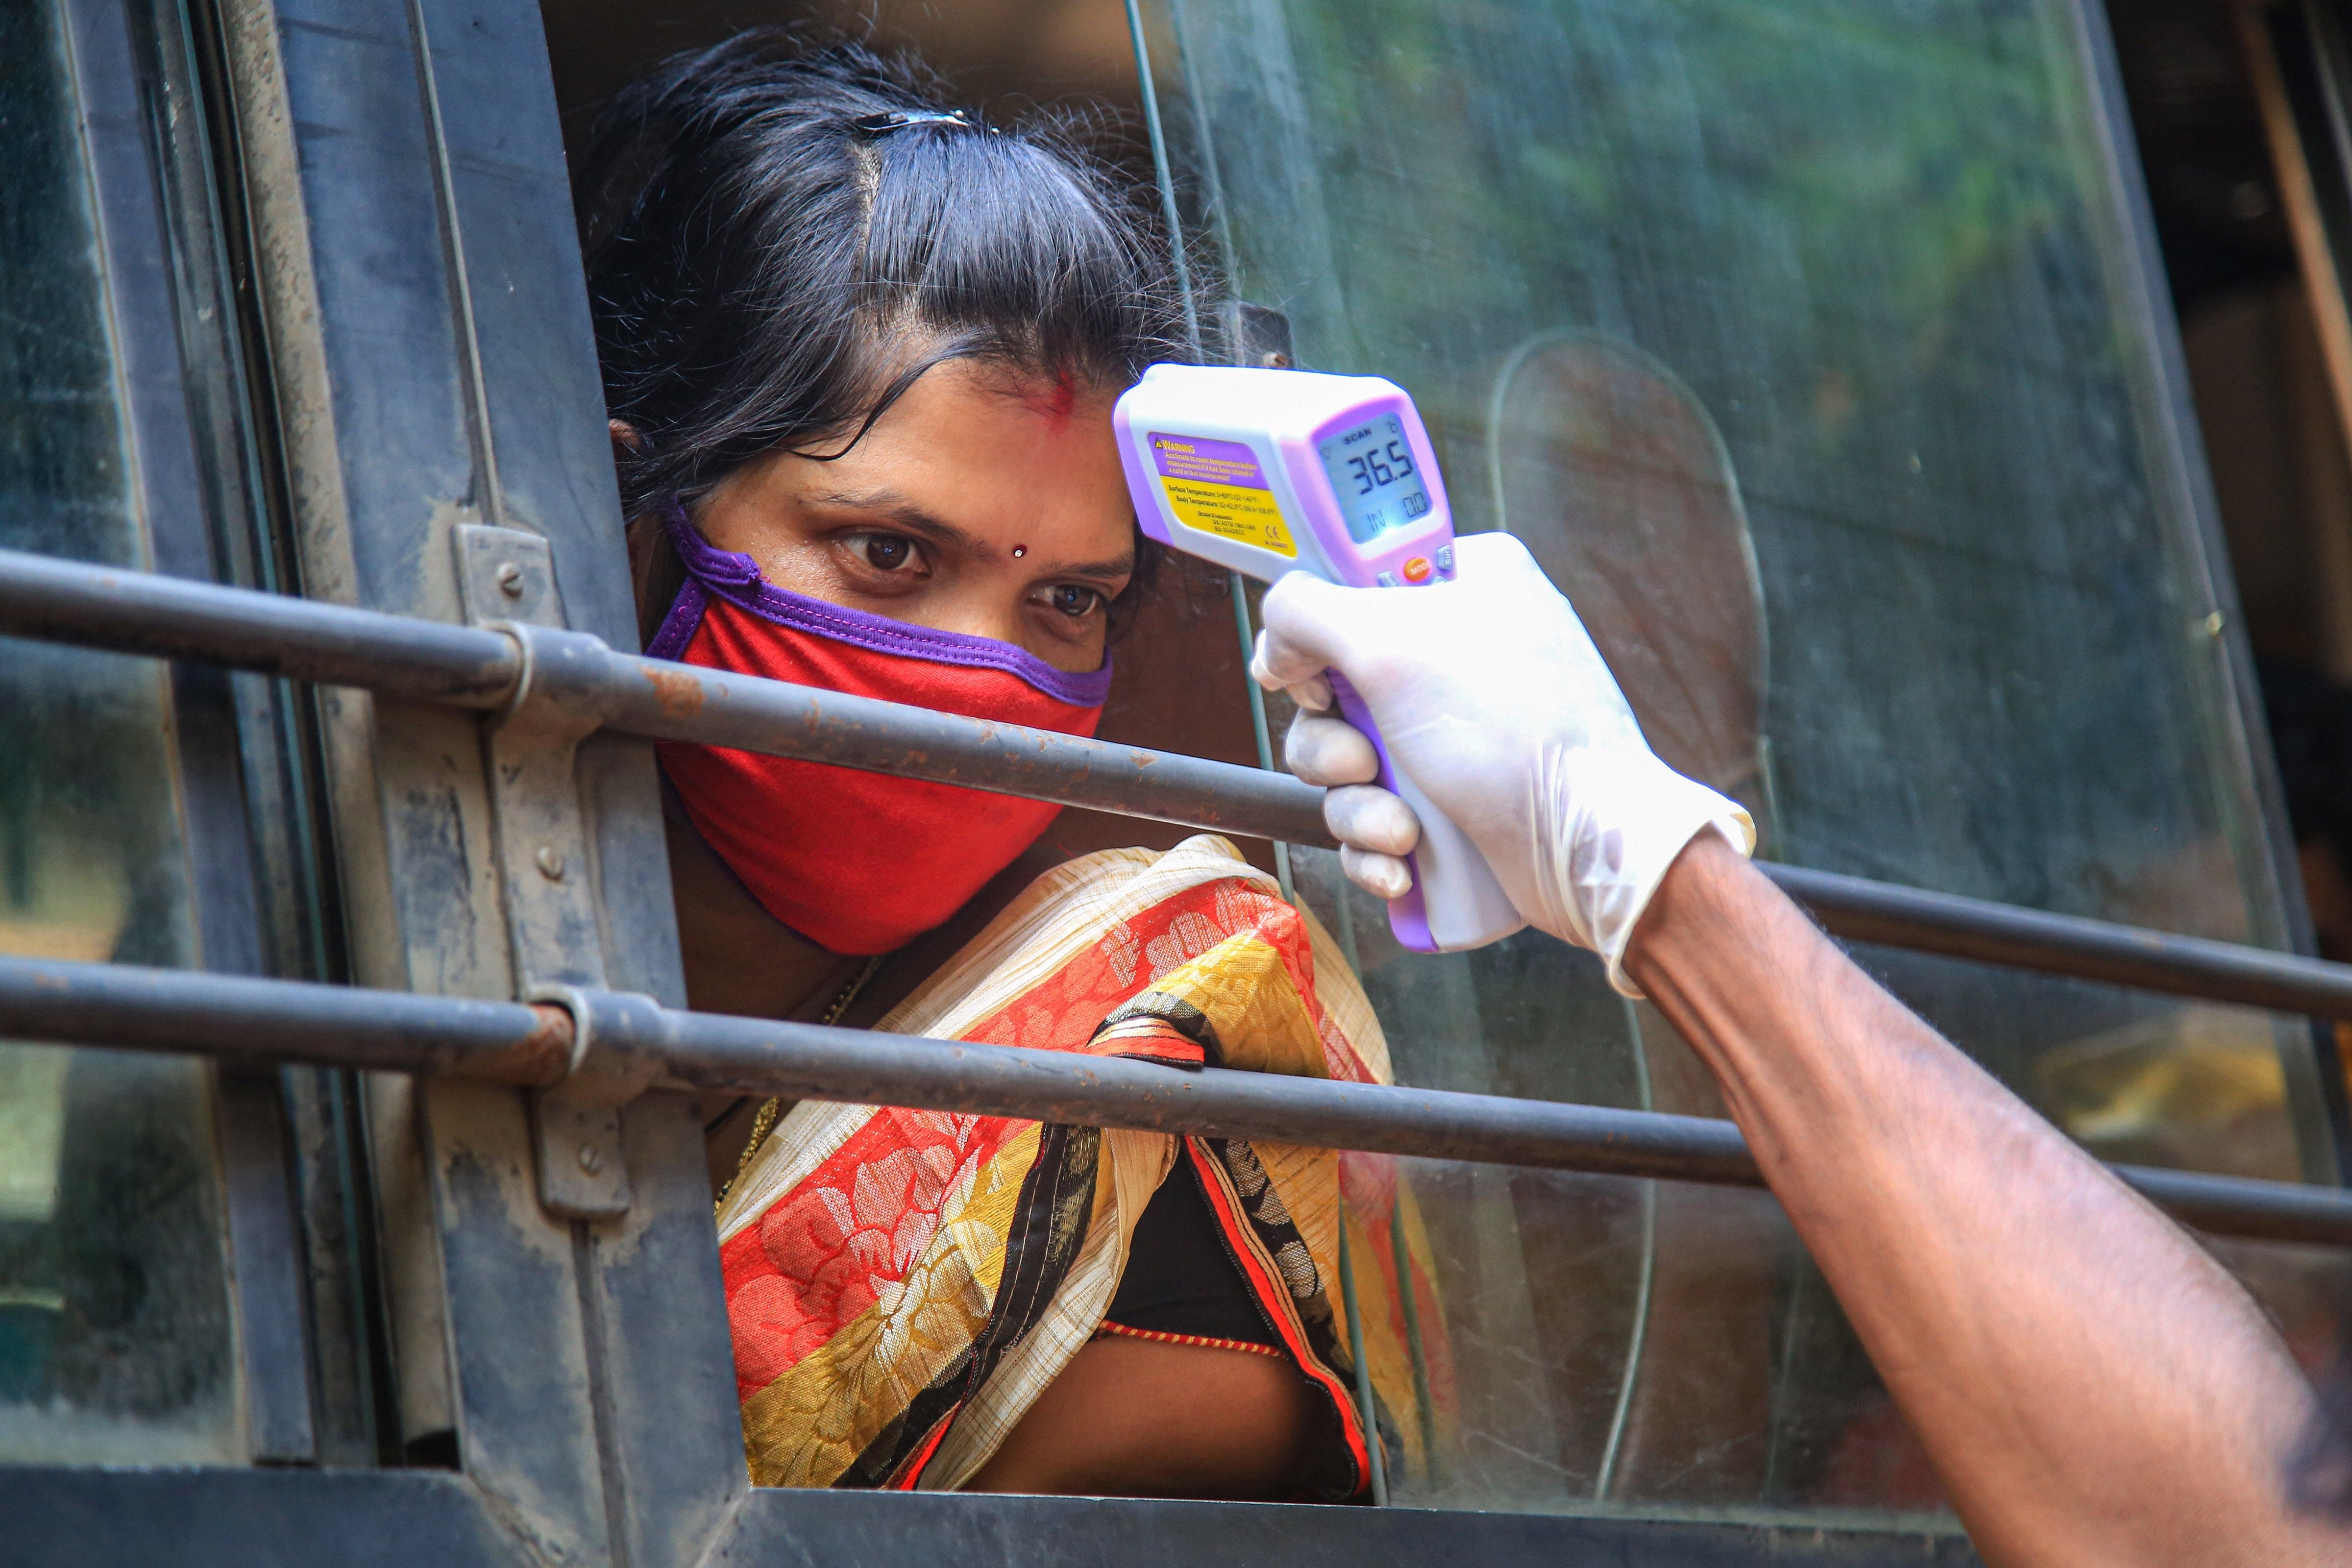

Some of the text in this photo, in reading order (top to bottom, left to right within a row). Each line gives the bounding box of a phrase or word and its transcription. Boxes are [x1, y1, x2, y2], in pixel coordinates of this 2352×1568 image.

[1344, 427, 1372, 444] SCAN
[1162, 440, 1195, 454] WARNING
[1165, 451, 1190, 461] Acclimate
[1209, 458, 1240, 467] temperature
[1167, 460, 1200, 469] measurement
[1348, 440, 1413, 495] 36.5
[1199, 472, 1230, 481] environment
[1168, 484, 1186, 492] Surface
[1186, 487, 1216, 497] Temperature:
[1176, 495, 1188, 504] Body
[1411, 560, 1432, 575] MODE
